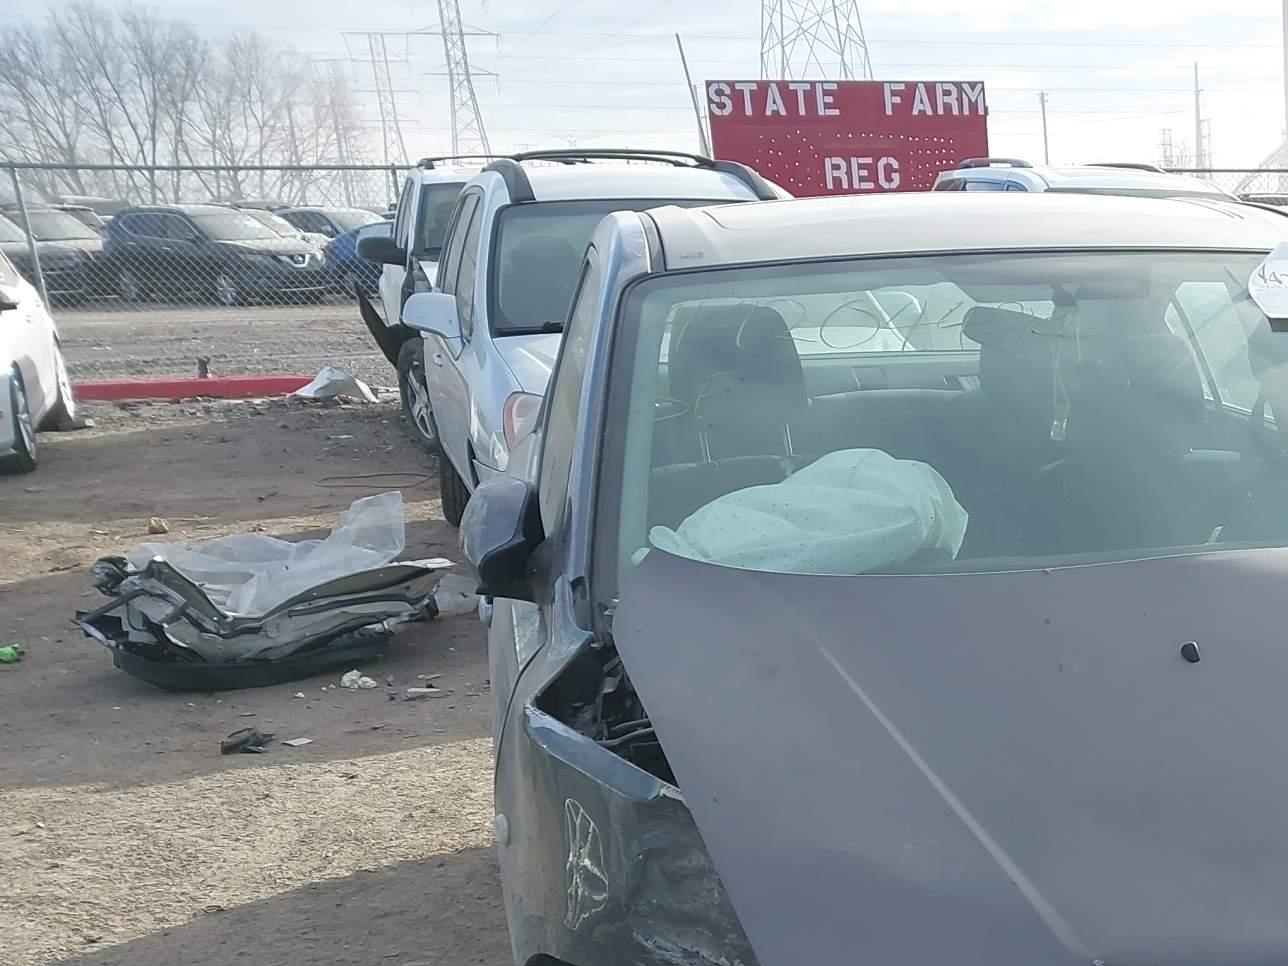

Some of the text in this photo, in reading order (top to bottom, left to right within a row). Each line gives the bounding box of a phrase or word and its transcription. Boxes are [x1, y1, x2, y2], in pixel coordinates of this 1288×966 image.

[707, 82, 986, 116] STATE FARM
[824, 156, 900, 190] REG
